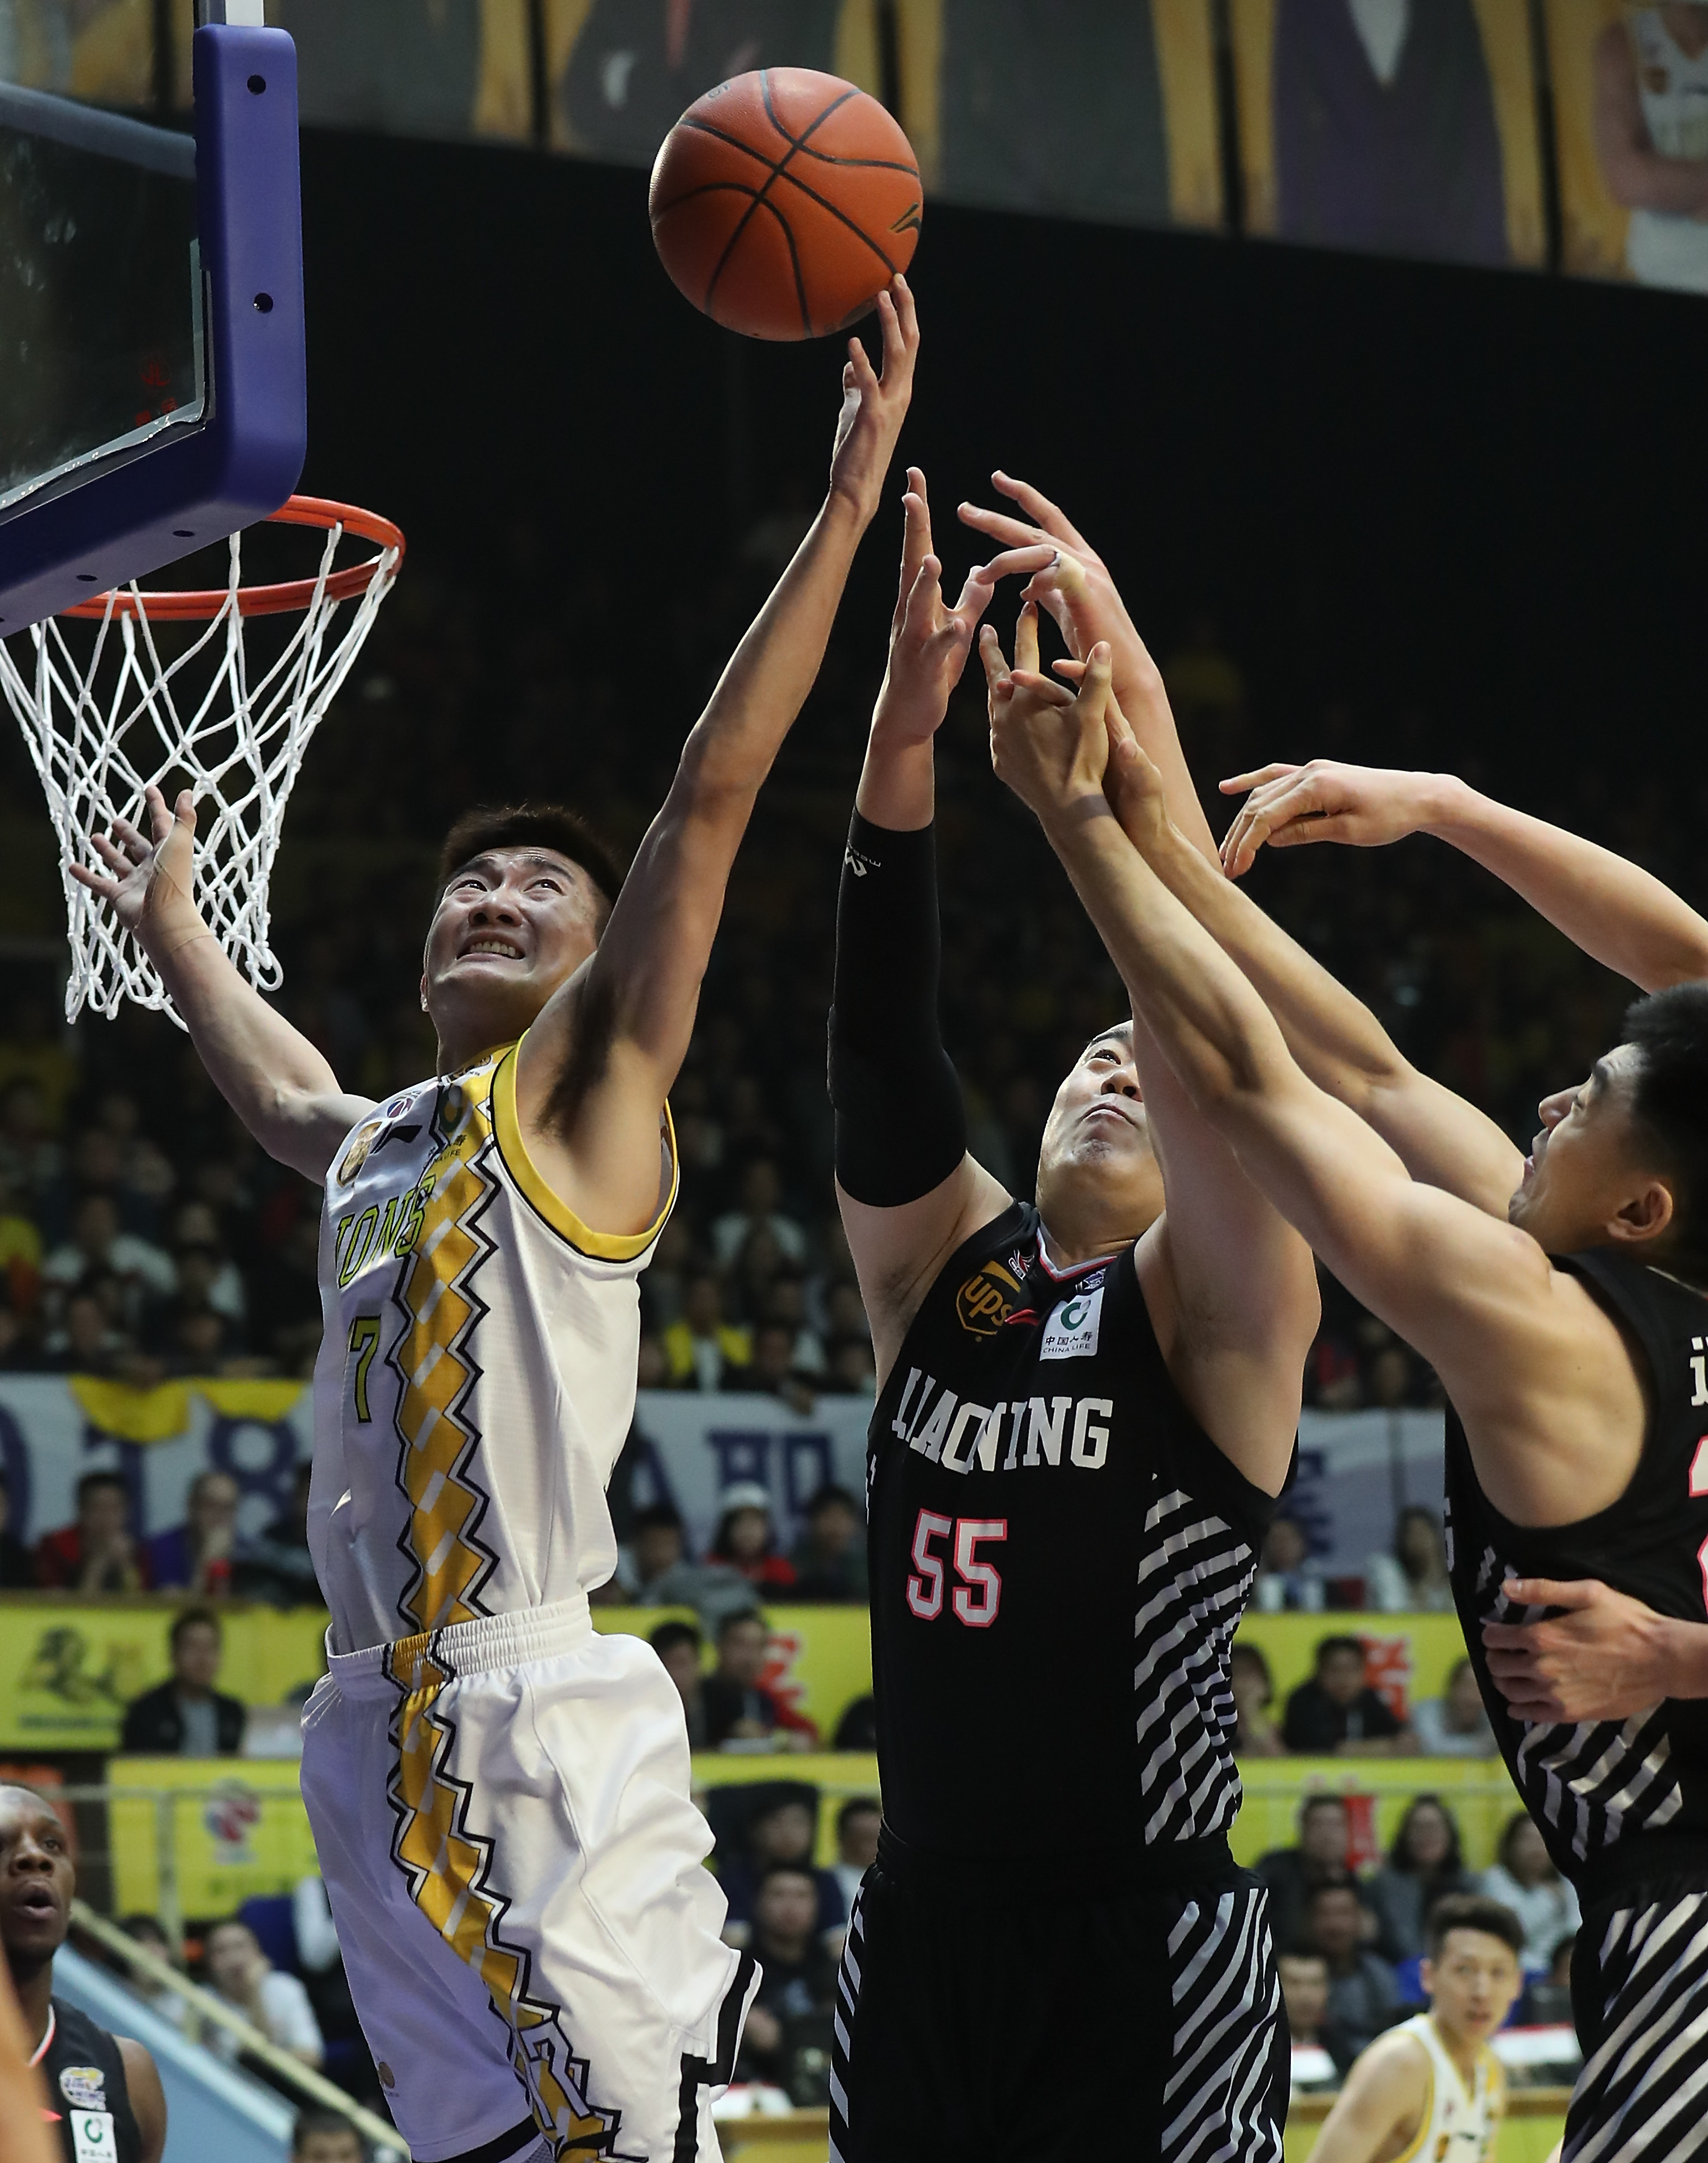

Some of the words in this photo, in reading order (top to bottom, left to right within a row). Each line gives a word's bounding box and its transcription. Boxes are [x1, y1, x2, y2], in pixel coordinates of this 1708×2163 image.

[348, 1313, 382, 1423] 7
[1045, 1331, 1093, 1346] 中国人寿
[892, 1366, 1114, 1476] LIAONING
[906, 1507, 1008, 1628] 55
